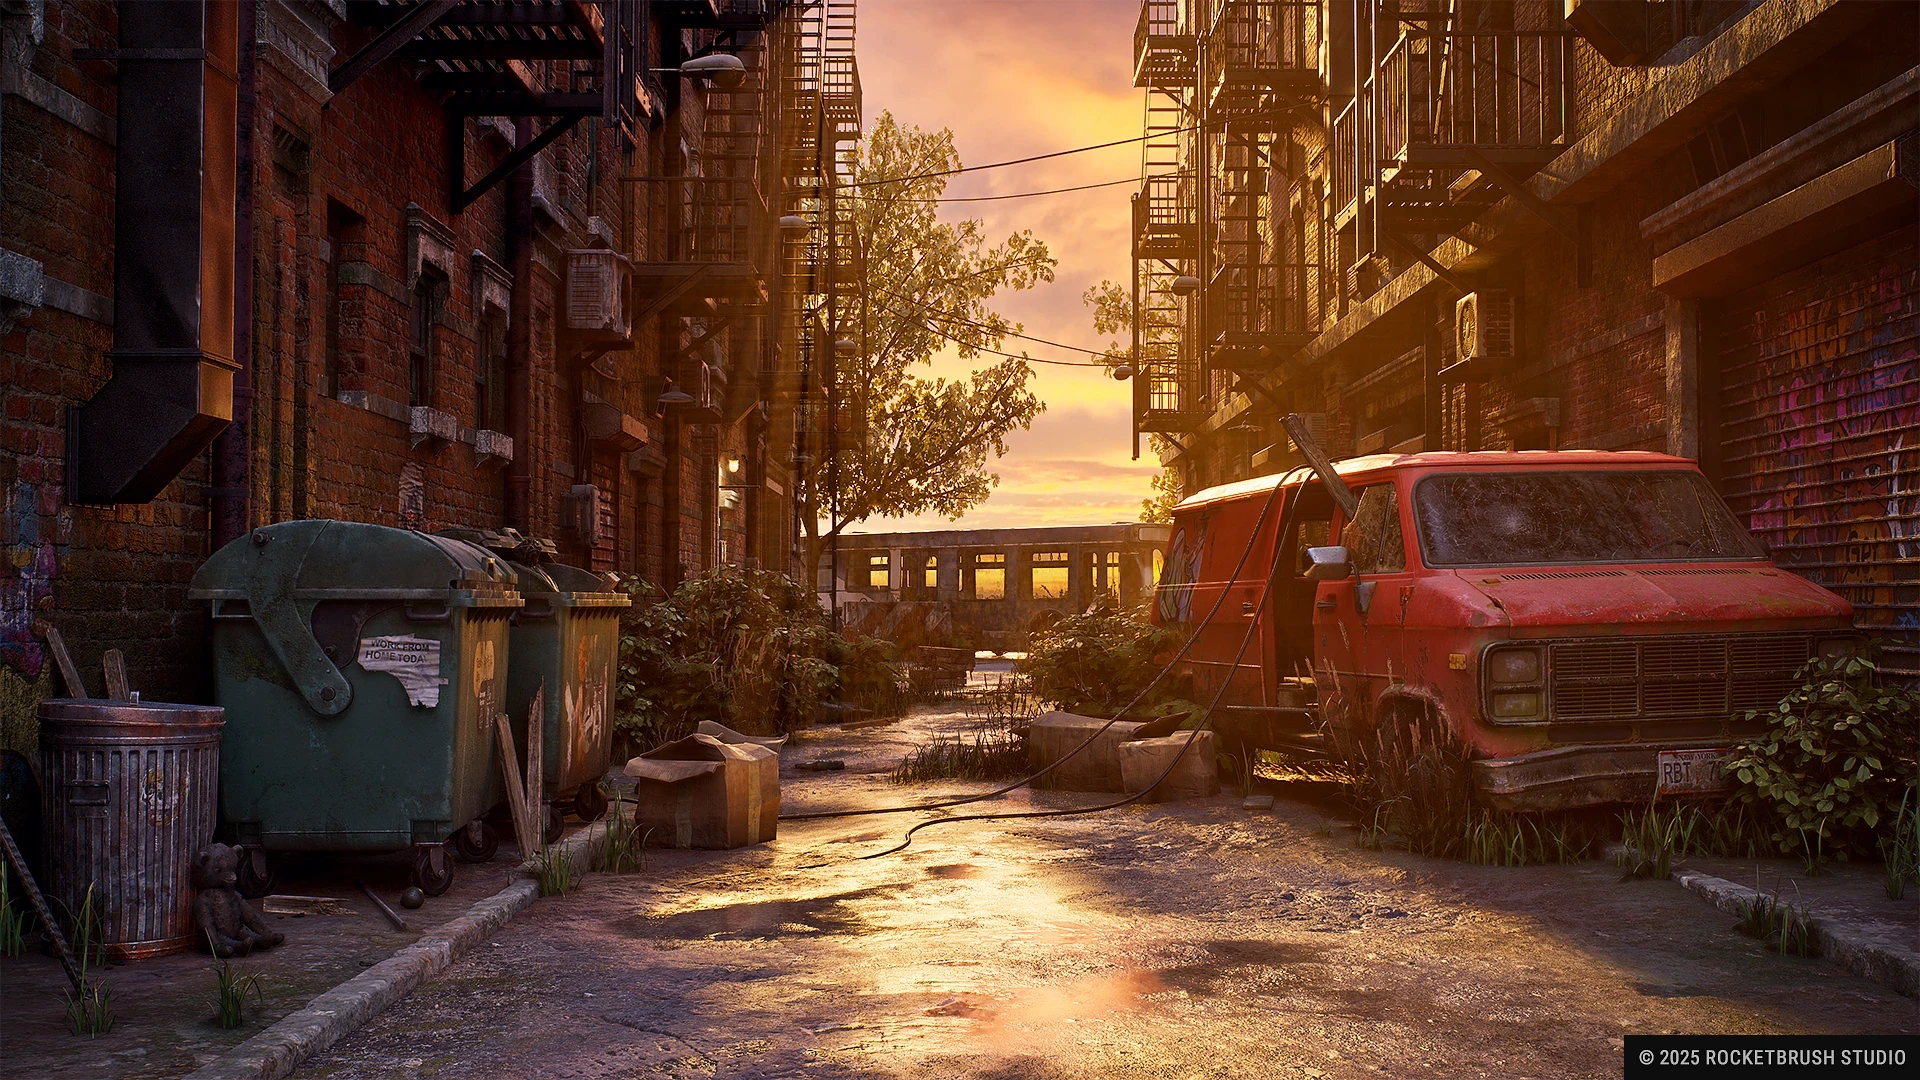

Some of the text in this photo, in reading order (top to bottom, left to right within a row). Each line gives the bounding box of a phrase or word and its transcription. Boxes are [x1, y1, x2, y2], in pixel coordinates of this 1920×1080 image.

[371, 640, 430, 652] WORK FROM
[365, 650, 396, 660] HOME
[1679, 752, 1716, 761] NEW YORK
[1663, 762, 1691, 783] RBT
